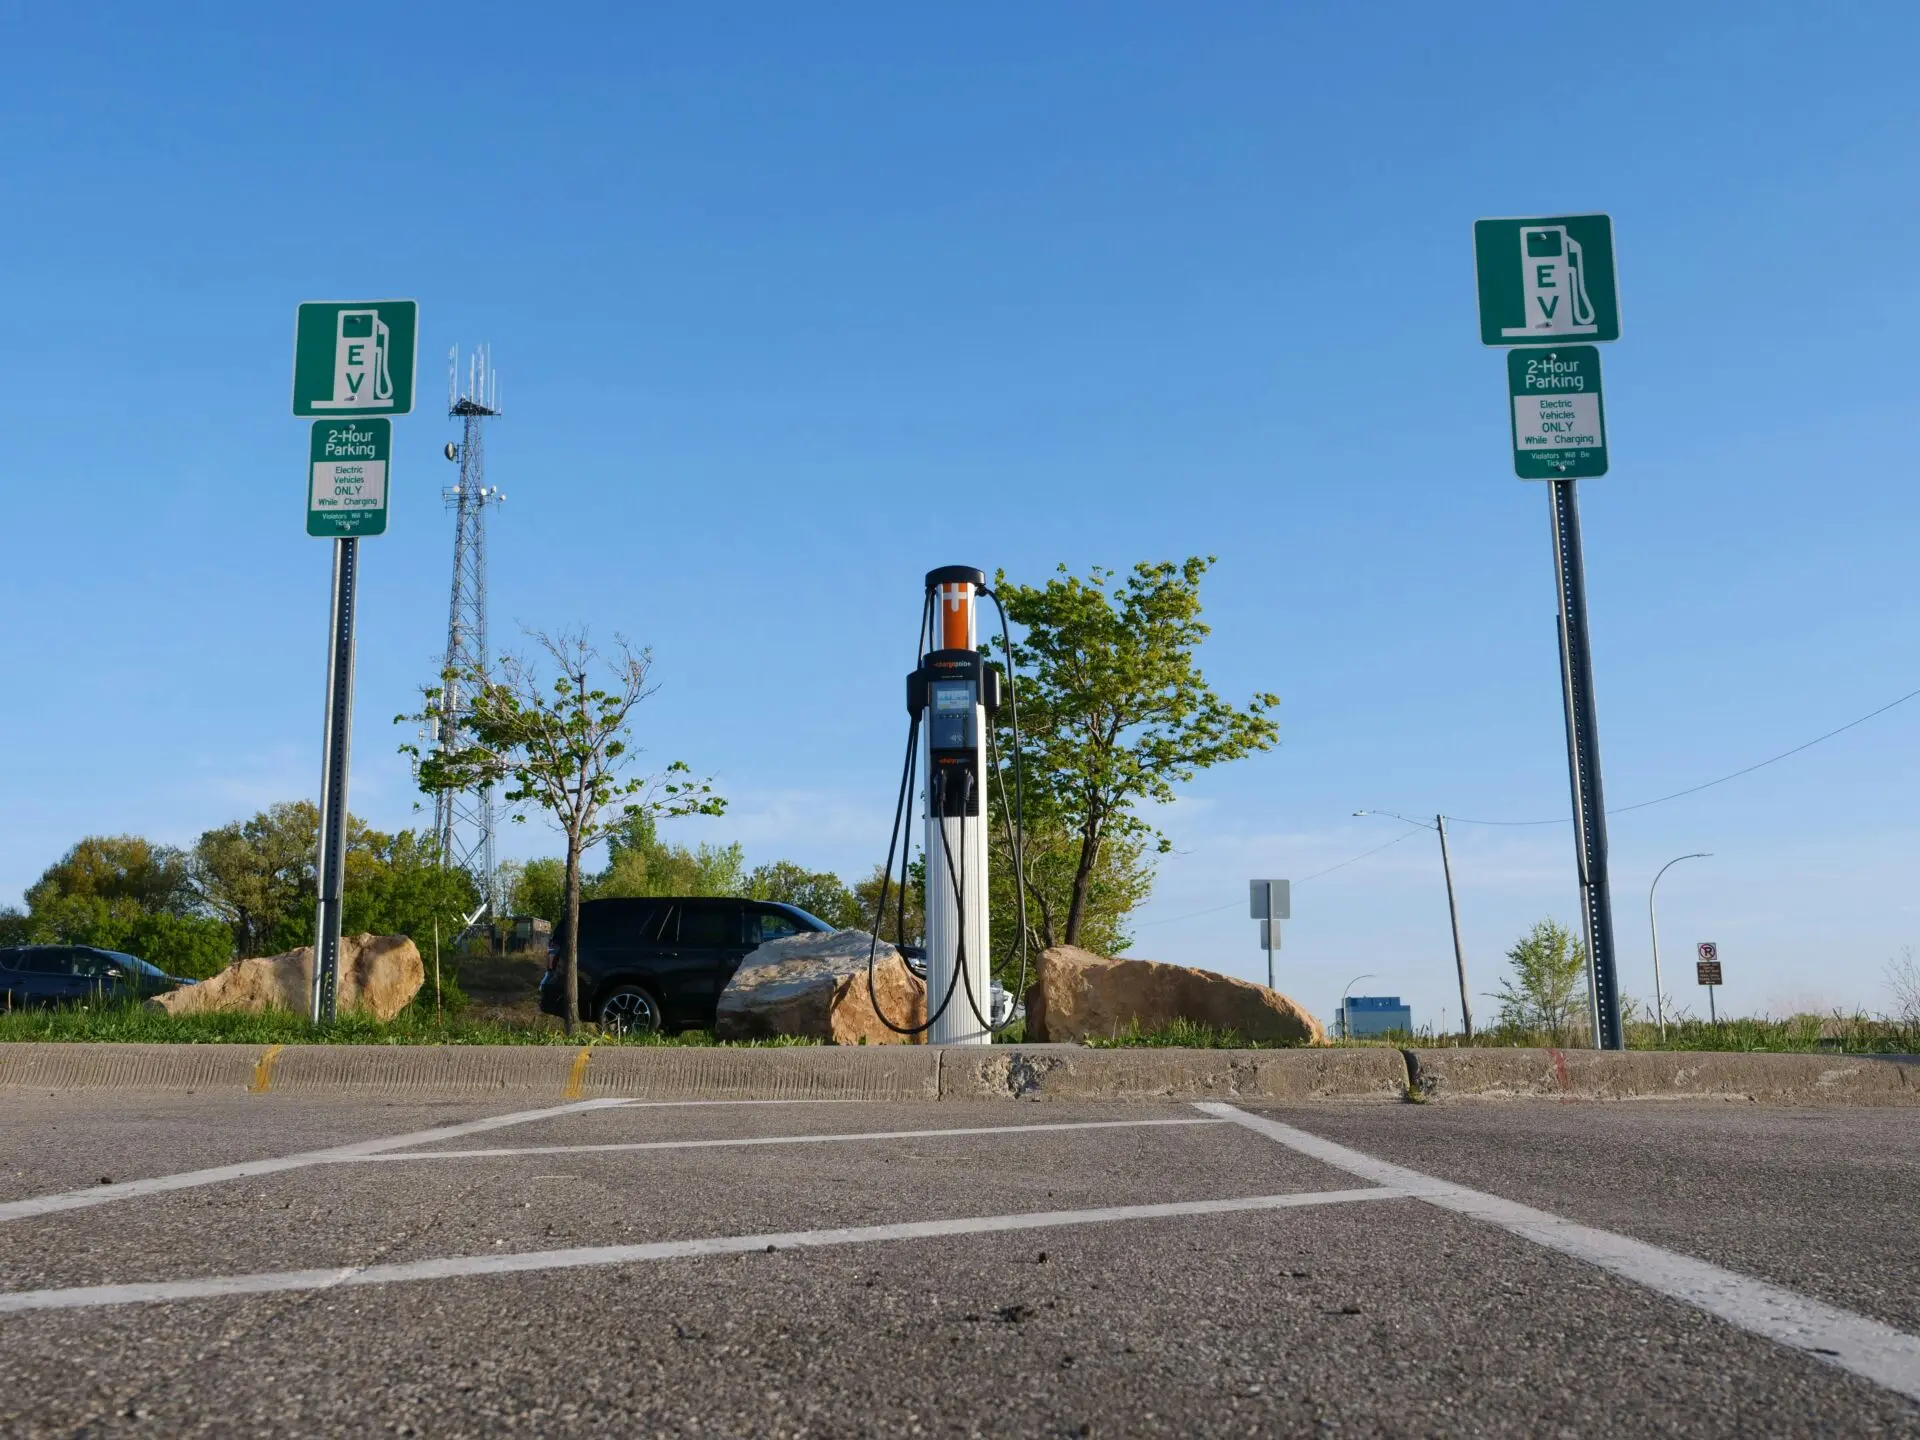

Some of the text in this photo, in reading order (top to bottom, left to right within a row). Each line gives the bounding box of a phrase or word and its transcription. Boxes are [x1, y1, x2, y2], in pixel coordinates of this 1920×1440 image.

[1536, 264, 1560, 319] EV
[346, 344, 365, 394] EV
[1527, 359, 1579, 374] 2-Hour
[1525, 373, 1584, 391] Parking
[1540, 400, 1572, 408] Electric
[1540, 410, 1576, 420] Vehicles
[1542, 422, 1573, 432] ONLY
[328, 430, 374, 442] 2-Hour
[1524, 434, 1594, 445] While Charging
[325, 443, 376, 458] Parking
[336, 466, 364, 474] Electric
[334, 476, 364, 484] Vehicles
[334, 486, 362, 496] ONLY
[344, 498, 378, 507] Charging
